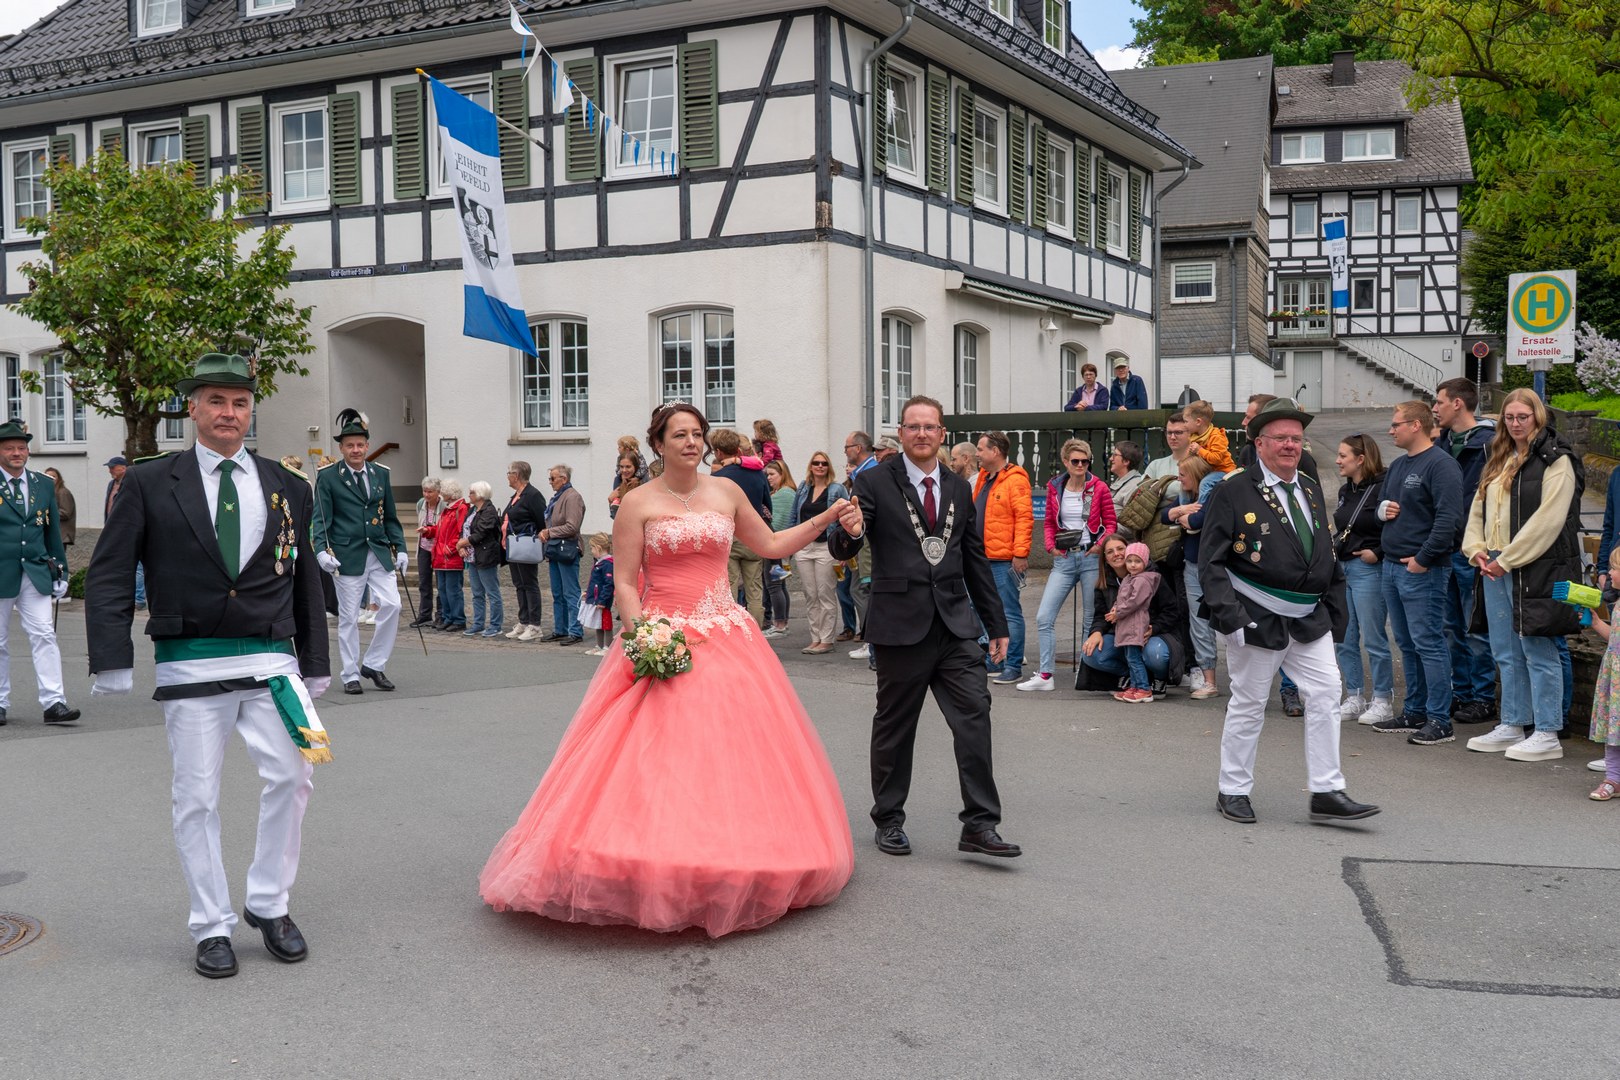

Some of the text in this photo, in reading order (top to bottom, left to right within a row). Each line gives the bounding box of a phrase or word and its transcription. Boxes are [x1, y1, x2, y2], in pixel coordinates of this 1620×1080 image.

[455, 152, 488, 177] EIHEIT
[1527, 288, 1556, 321] H
[1522, 336, 1558, 345] Ersatz-
[1517, 347, 1562, 357] haltestelle
